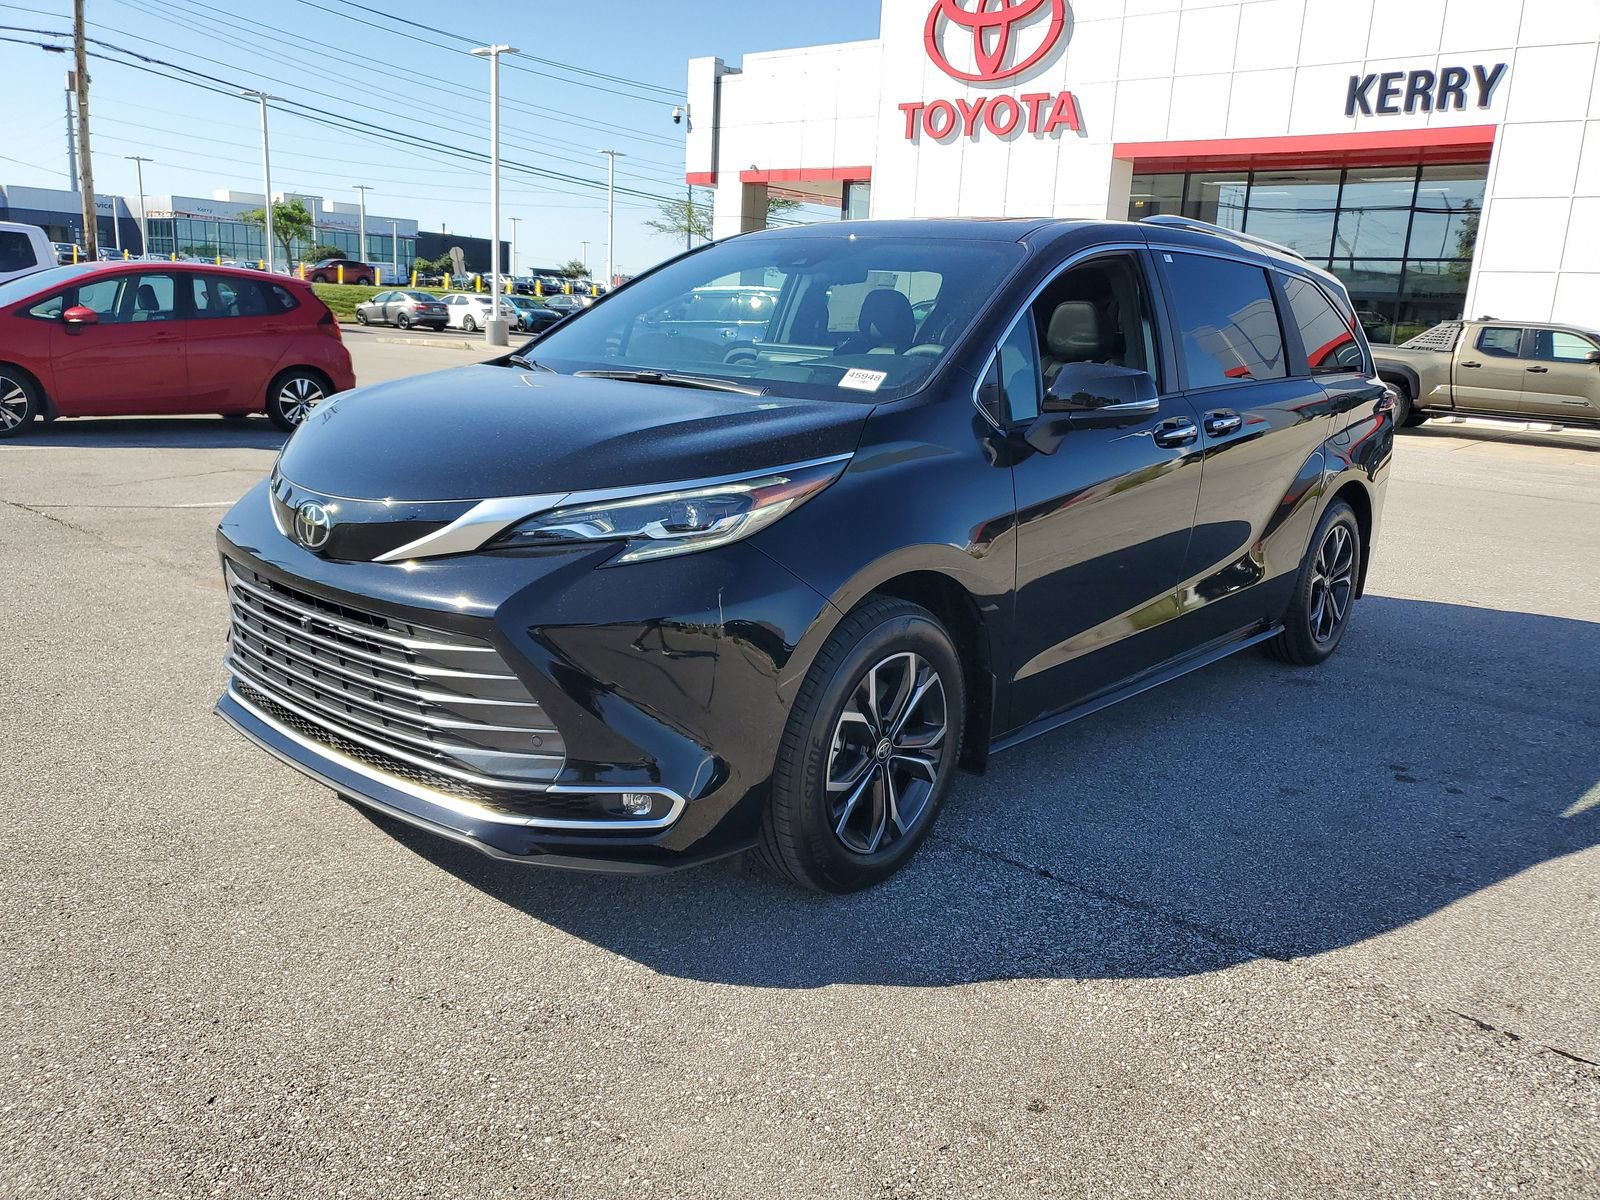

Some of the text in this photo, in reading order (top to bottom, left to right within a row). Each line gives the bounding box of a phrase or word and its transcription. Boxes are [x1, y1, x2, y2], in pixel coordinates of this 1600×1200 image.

[1344, 63, 1507, 116] KERRY
[898, 91, 1080, 140] TOYOTA
[849, 371, 881, 381] 45948
